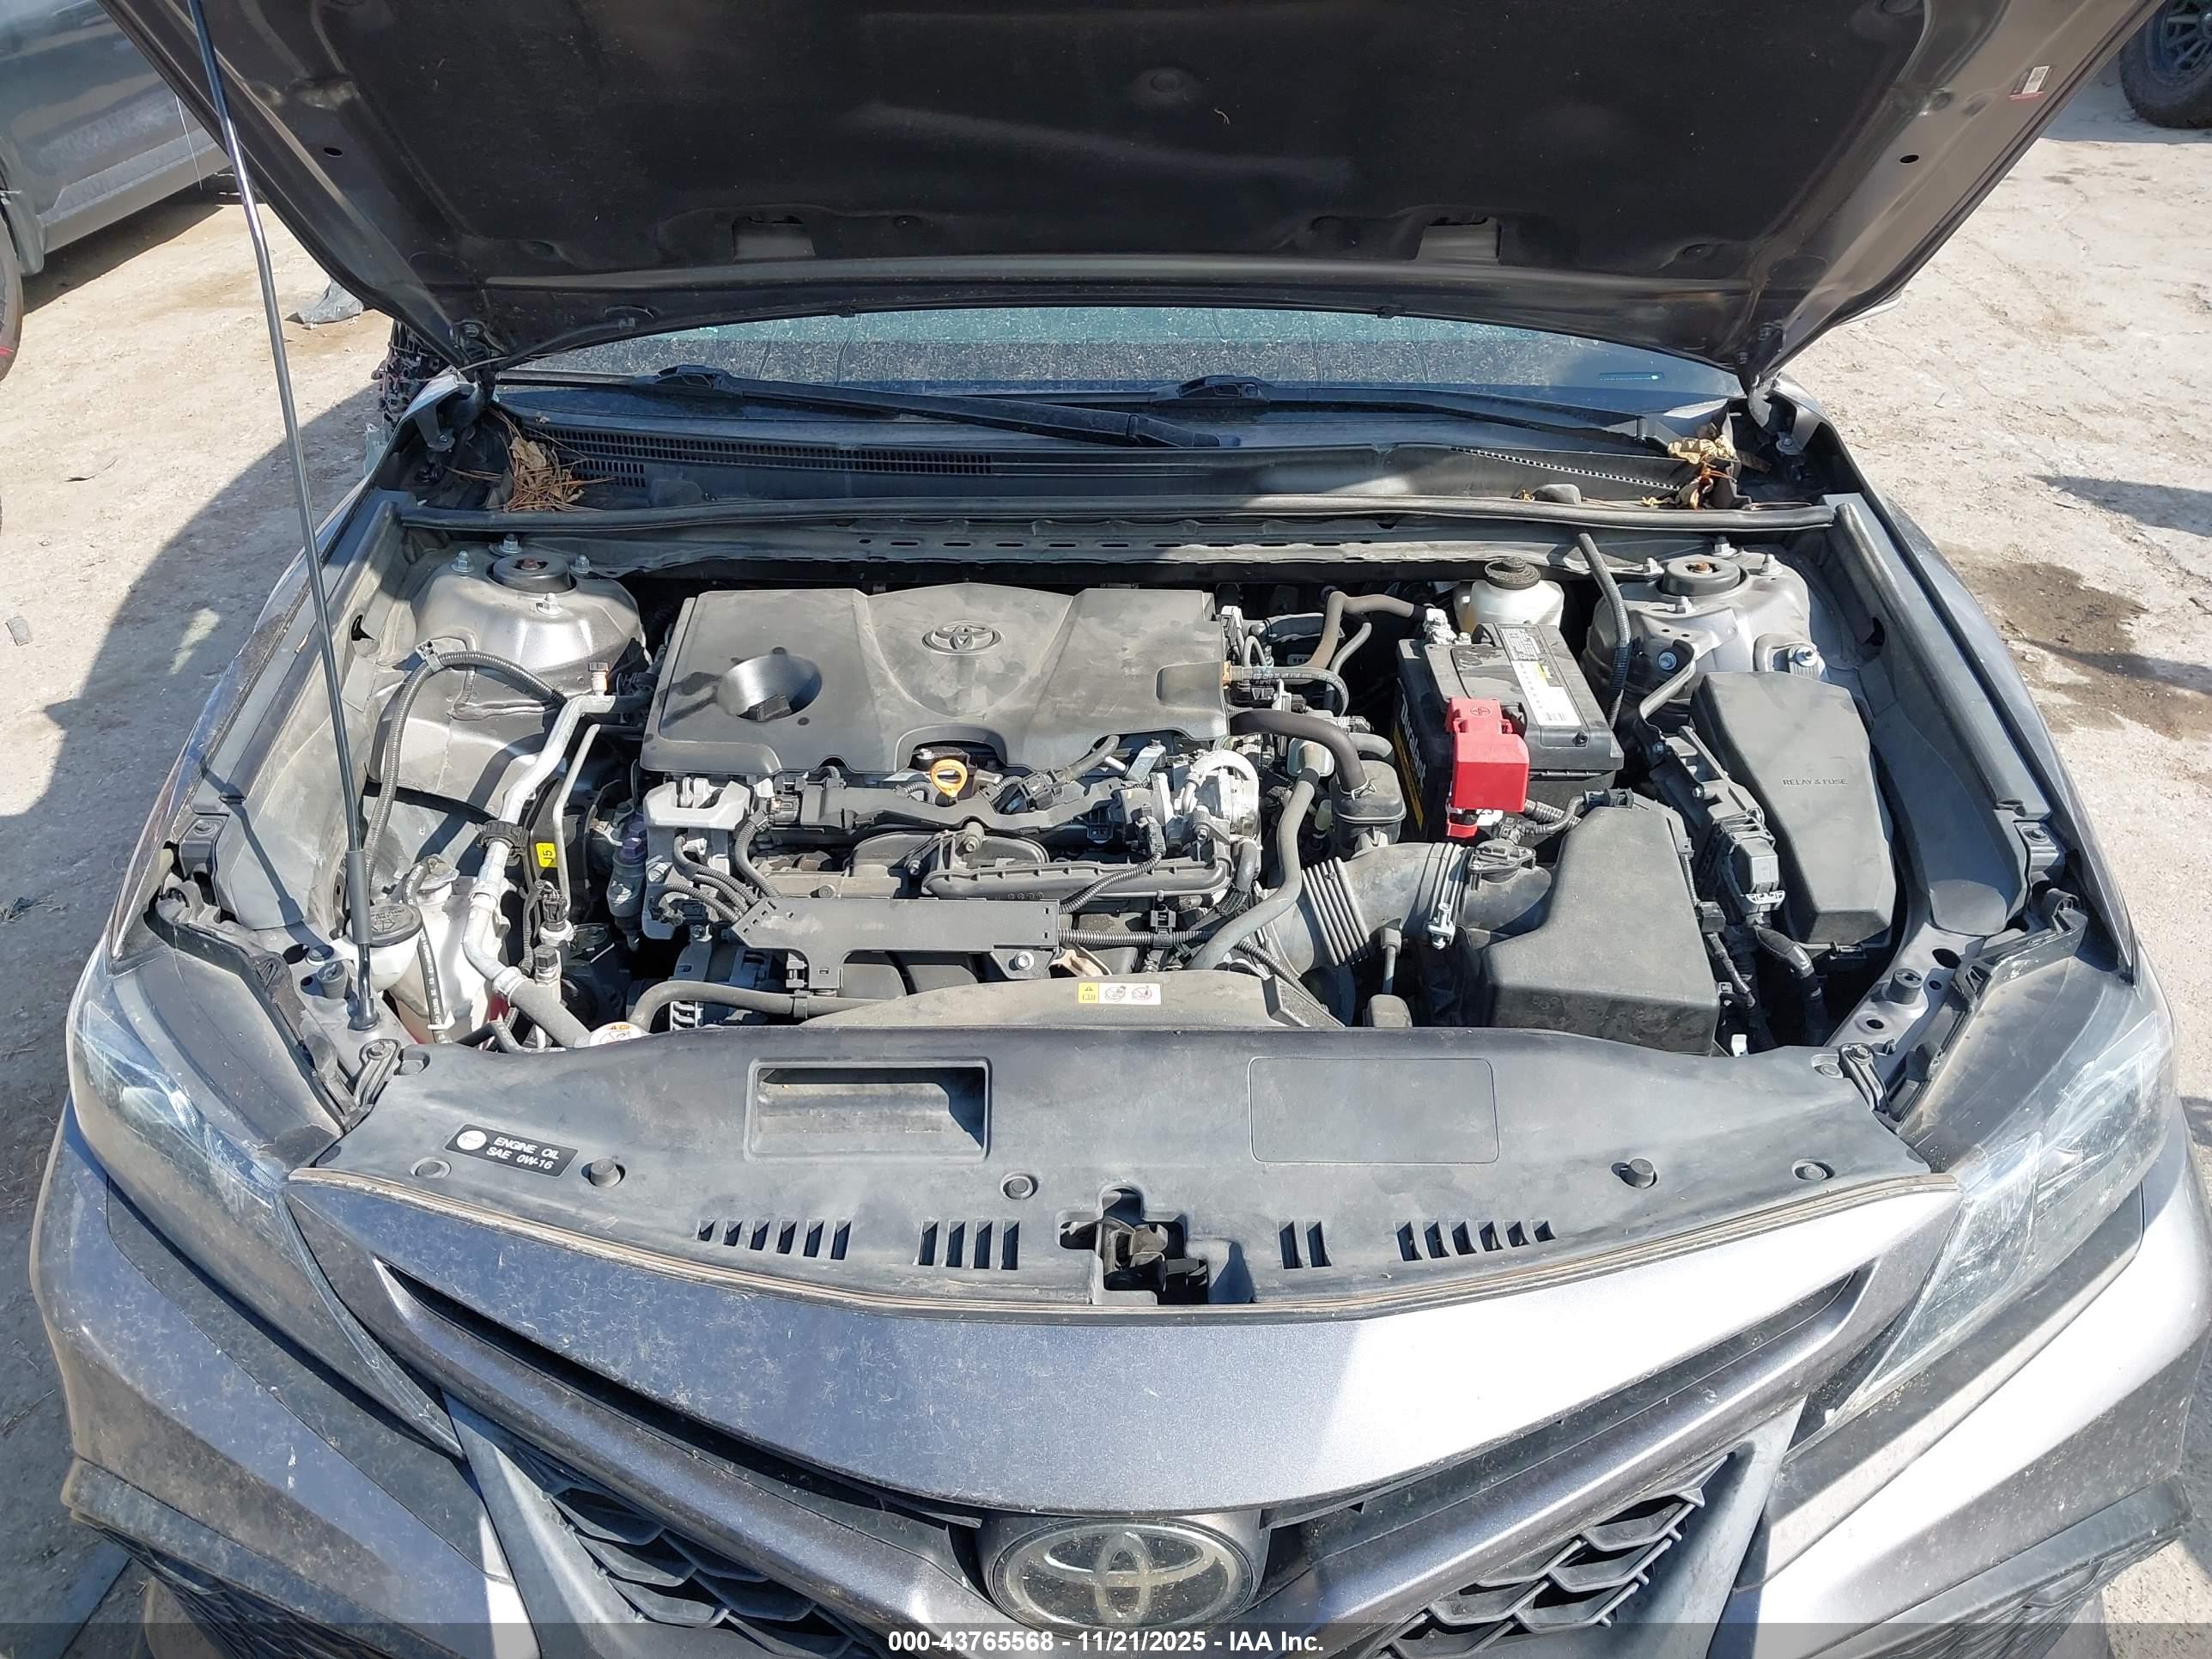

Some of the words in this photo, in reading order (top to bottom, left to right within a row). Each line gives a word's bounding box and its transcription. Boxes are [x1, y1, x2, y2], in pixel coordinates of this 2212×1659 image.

[1401, 693, 1426, 789] Duralast
[486, 1146, 513, 1160] SAE
[516, 1154, 555, 1170] 0W-16
[494, 1136, 538, 1154] ENGINE
[541, 1148, 560, 1160] OIL
